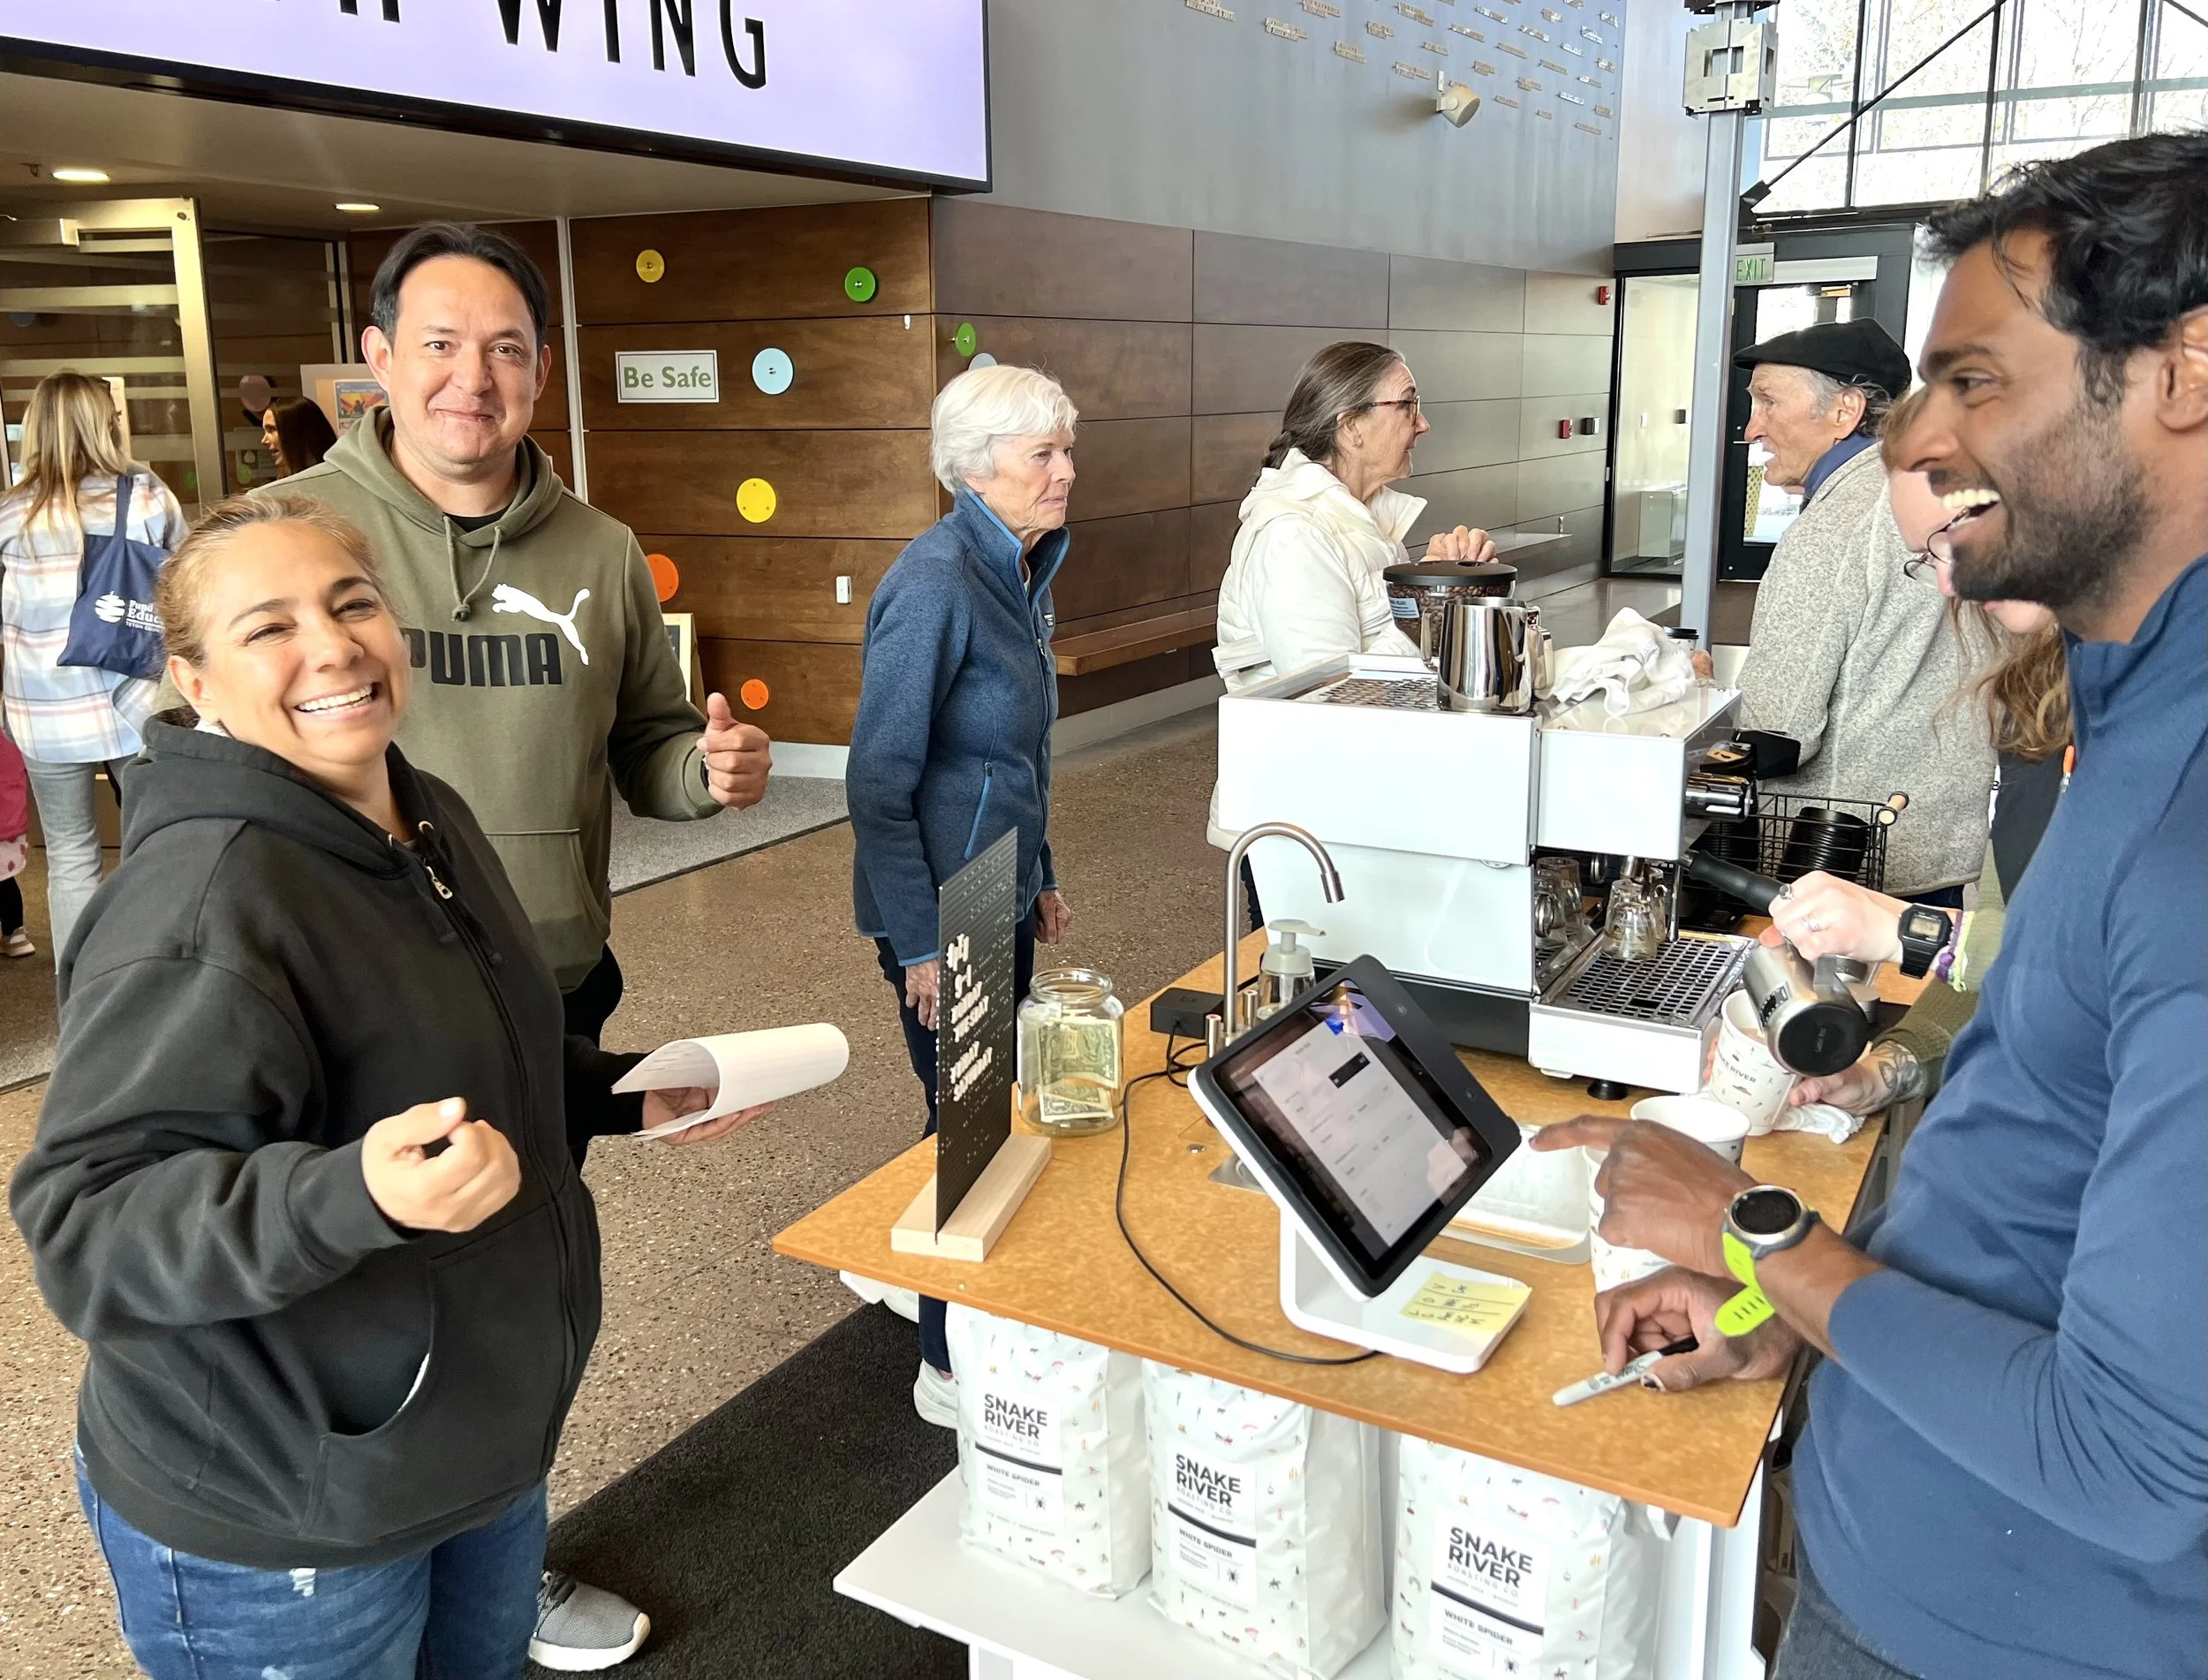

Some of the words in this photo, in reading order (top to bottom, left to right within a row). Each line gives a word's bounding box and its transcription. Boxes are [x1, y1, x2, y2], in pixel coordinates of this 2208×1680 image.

[1735, 258, 1766, 282] EXIT
[624, 367, 654, 388] Be
[662, 366, 712, 388] Safe
[1730, 1065, 1757, 1084] RIVER
[985, 1393, 1047, 1426] SNAKE
[985, 1408, 1040, 1439] RIVER
[987, 1464, 1009, 1477] WHITE
[1012, 1472, 1040, 1486] SPIDER
[1176, 1453, 1241, 1494] SNAKE
[1176, 1469, 1232, 1508] RIVER
[1179, 1527, 1201, 1545] WHITE
[1203, 1540, 1232, 1558] SPIDER
[1449, 1525, 1533, 1574] SNAKE
[1448, 1543, 1521, 1589] RIVER
[1444, 1608, 1474, 1629] WHITE
[1477, 1623, 1513, 1645] SPIDER
